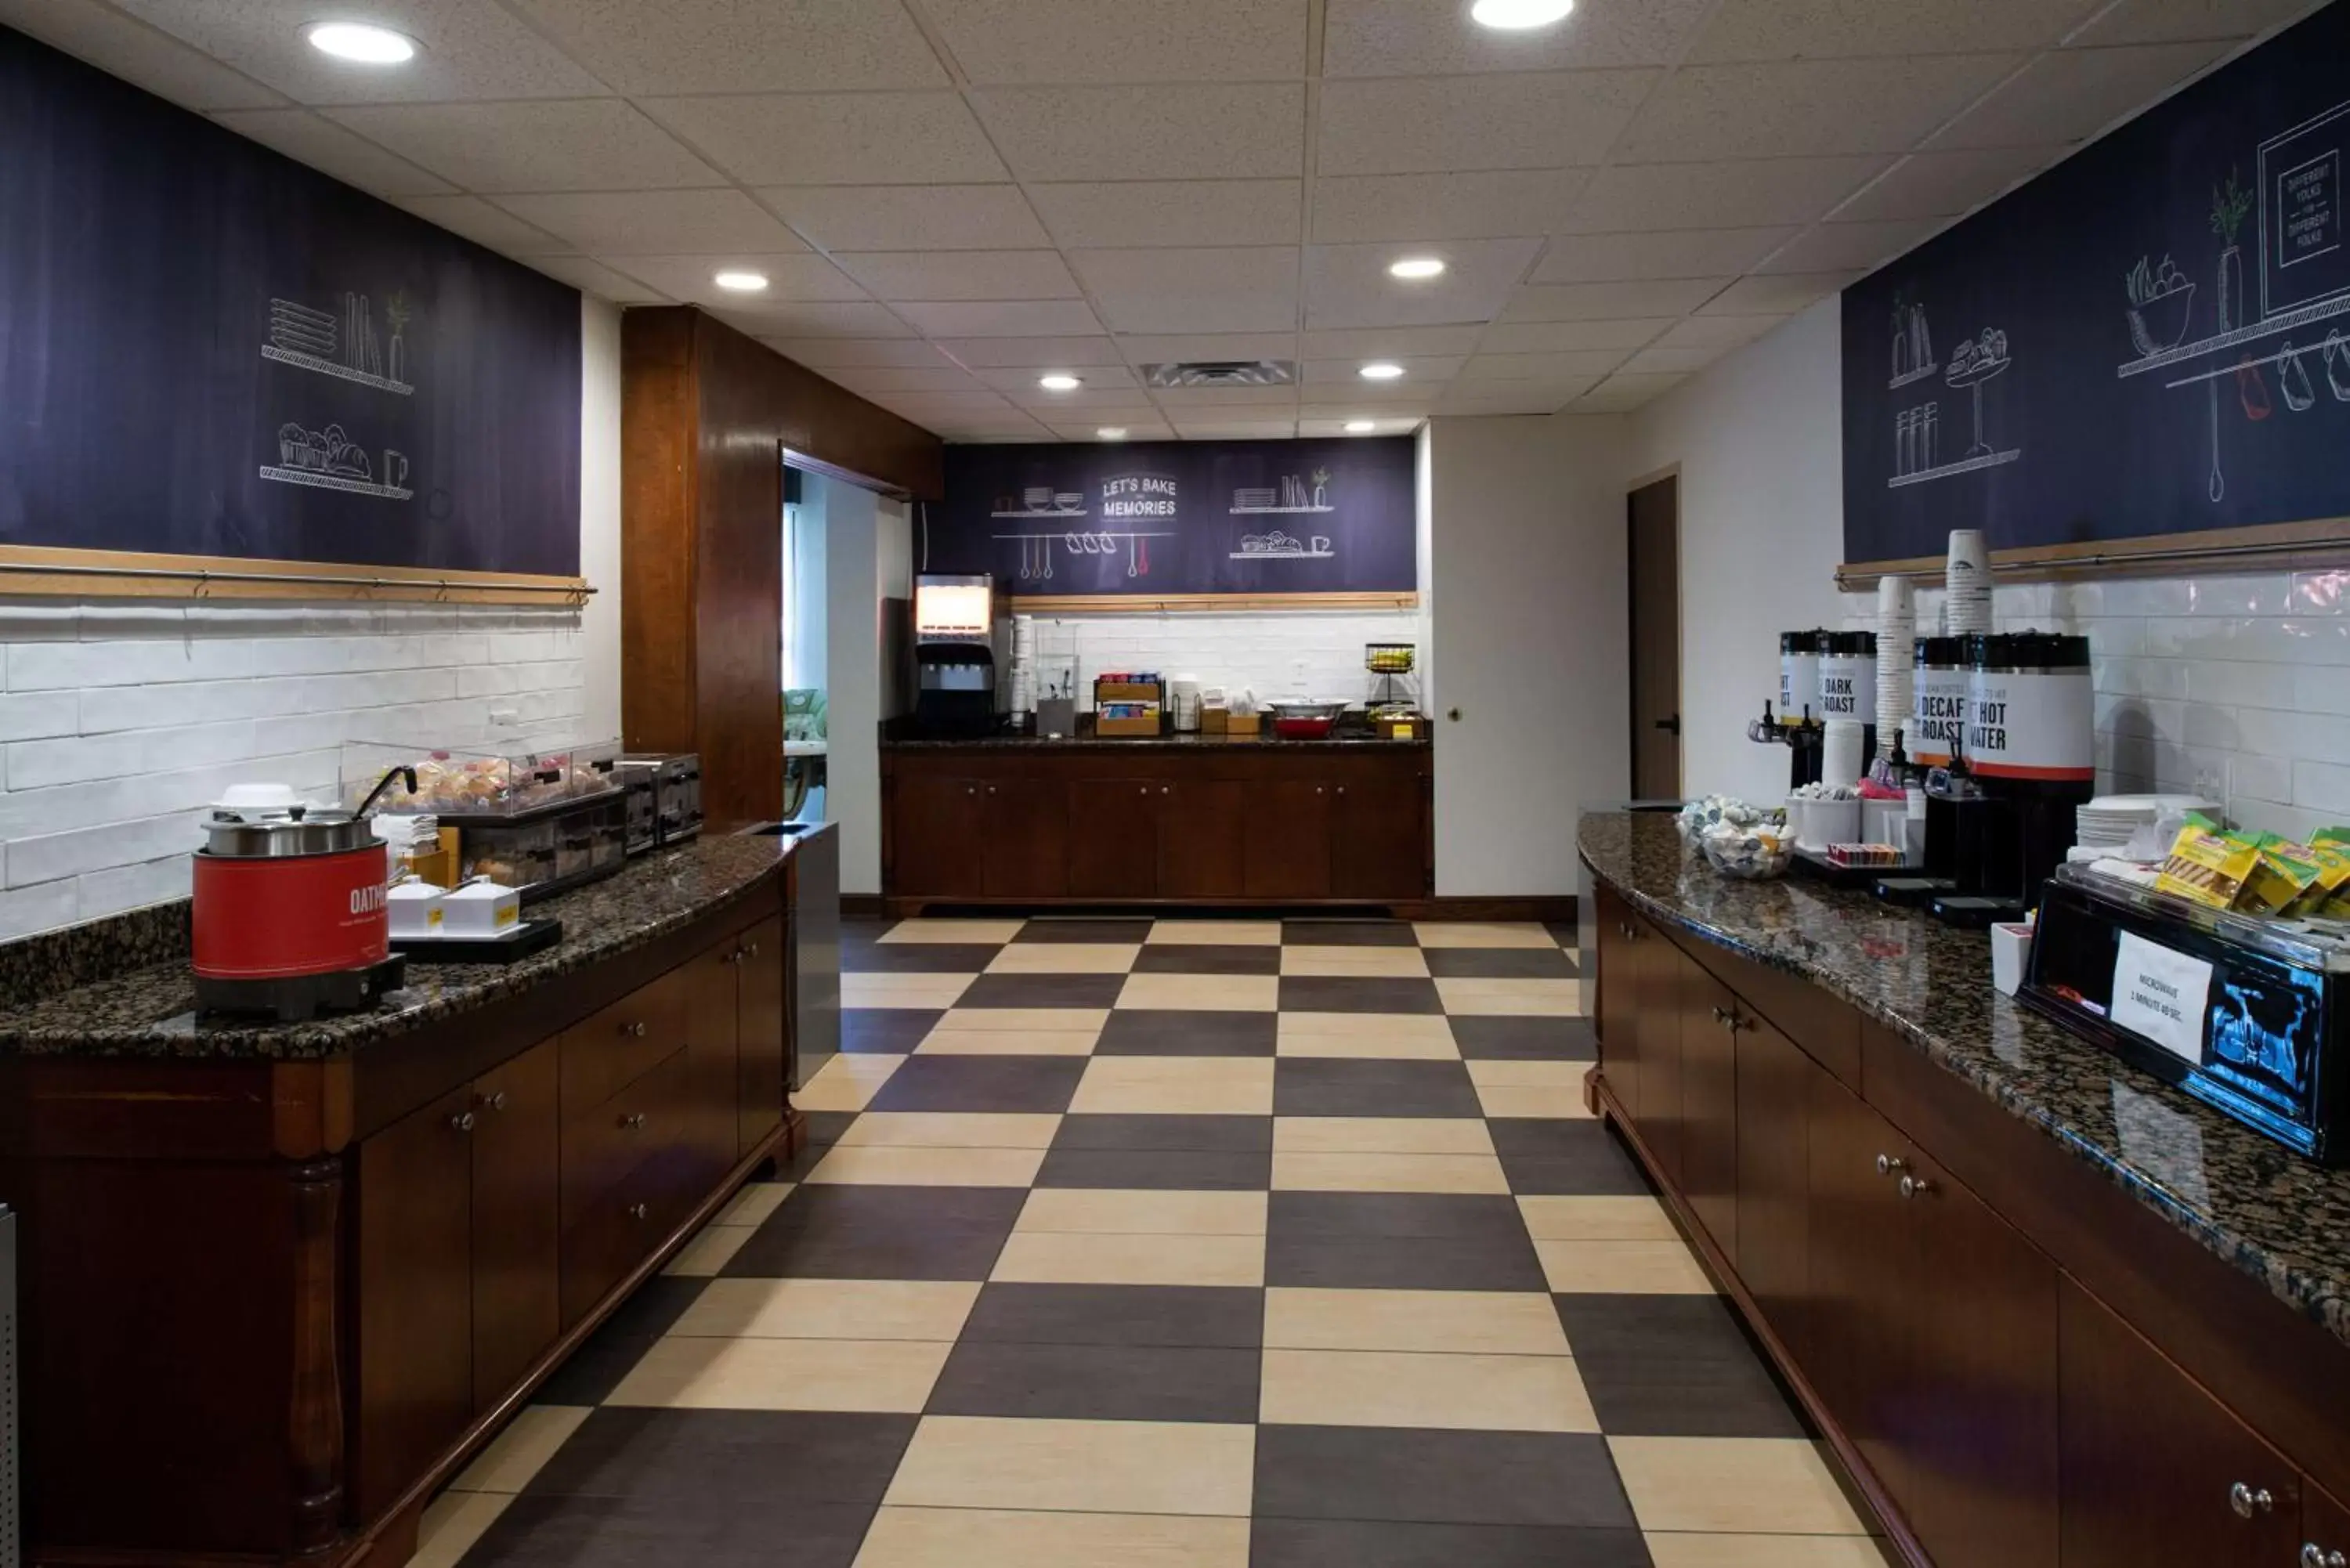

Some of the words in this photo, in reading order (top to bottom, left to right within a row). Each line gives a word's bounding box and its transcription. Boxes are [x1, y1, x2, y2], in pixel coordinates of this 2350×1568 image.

[1103, 478, 1138, 497] LET'S
[1142, 478, 1176, 496] BAKE
[1104, 500, 1176, 516] MEMORIES
[1824, 677, 1853, 695] DARK
[1824, 696, 1856, 713] ROAST
[1922, 696, 1965, 718] DECAF
[1979, 702, 2007, 725] HOT
[1922, 719, 1965, 742] ROAST
[2139, 973, 2179, 999] MICROWAVE
[2135, 992, 2160, 1013] MINUTE
